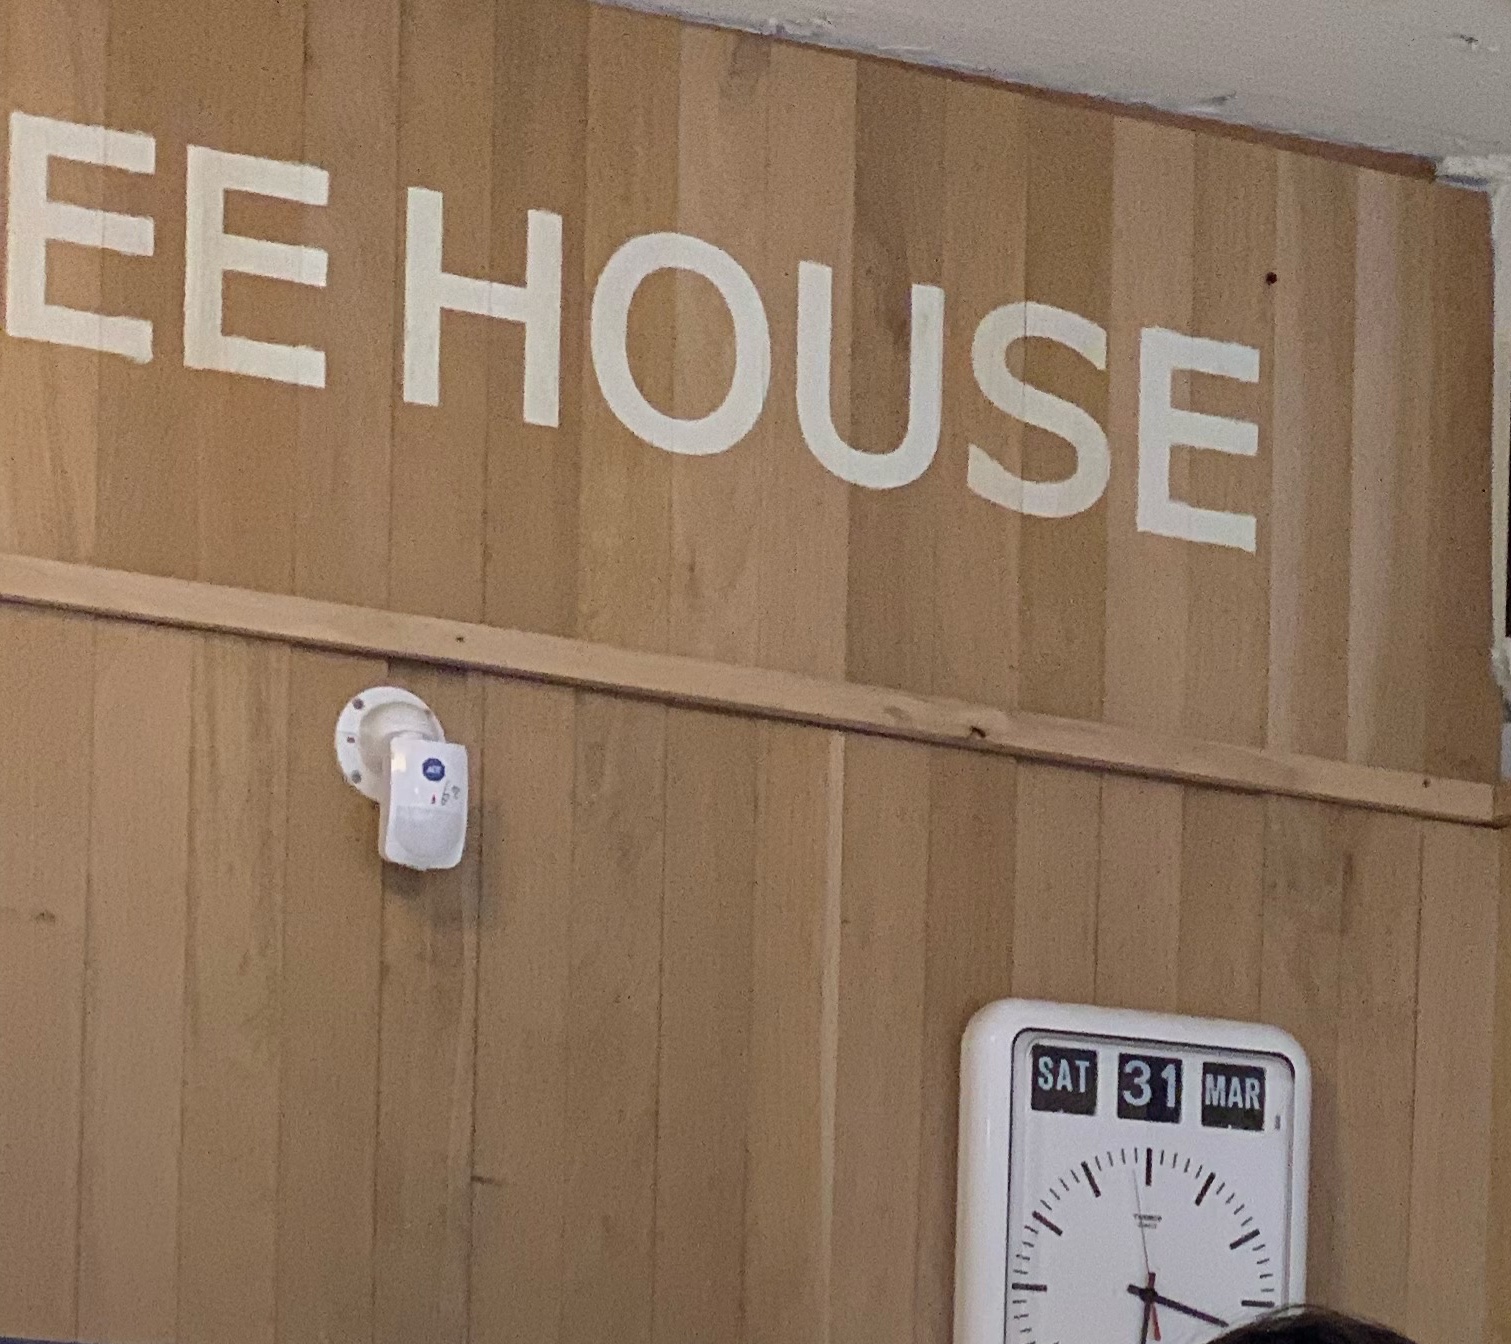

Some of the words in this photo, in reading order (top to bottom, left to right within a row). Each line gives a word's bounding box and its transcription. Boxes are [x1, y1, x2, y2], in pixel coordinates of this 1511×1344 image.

[5, 111, 329, 389] EE
[402, 186, 1261, 552] HOUSE
[1037, 1055, 1091, 1093] SAT
[1122, 1059, 1178, 1109] 31
[1204, 1072, 1261, 1111] MAR
